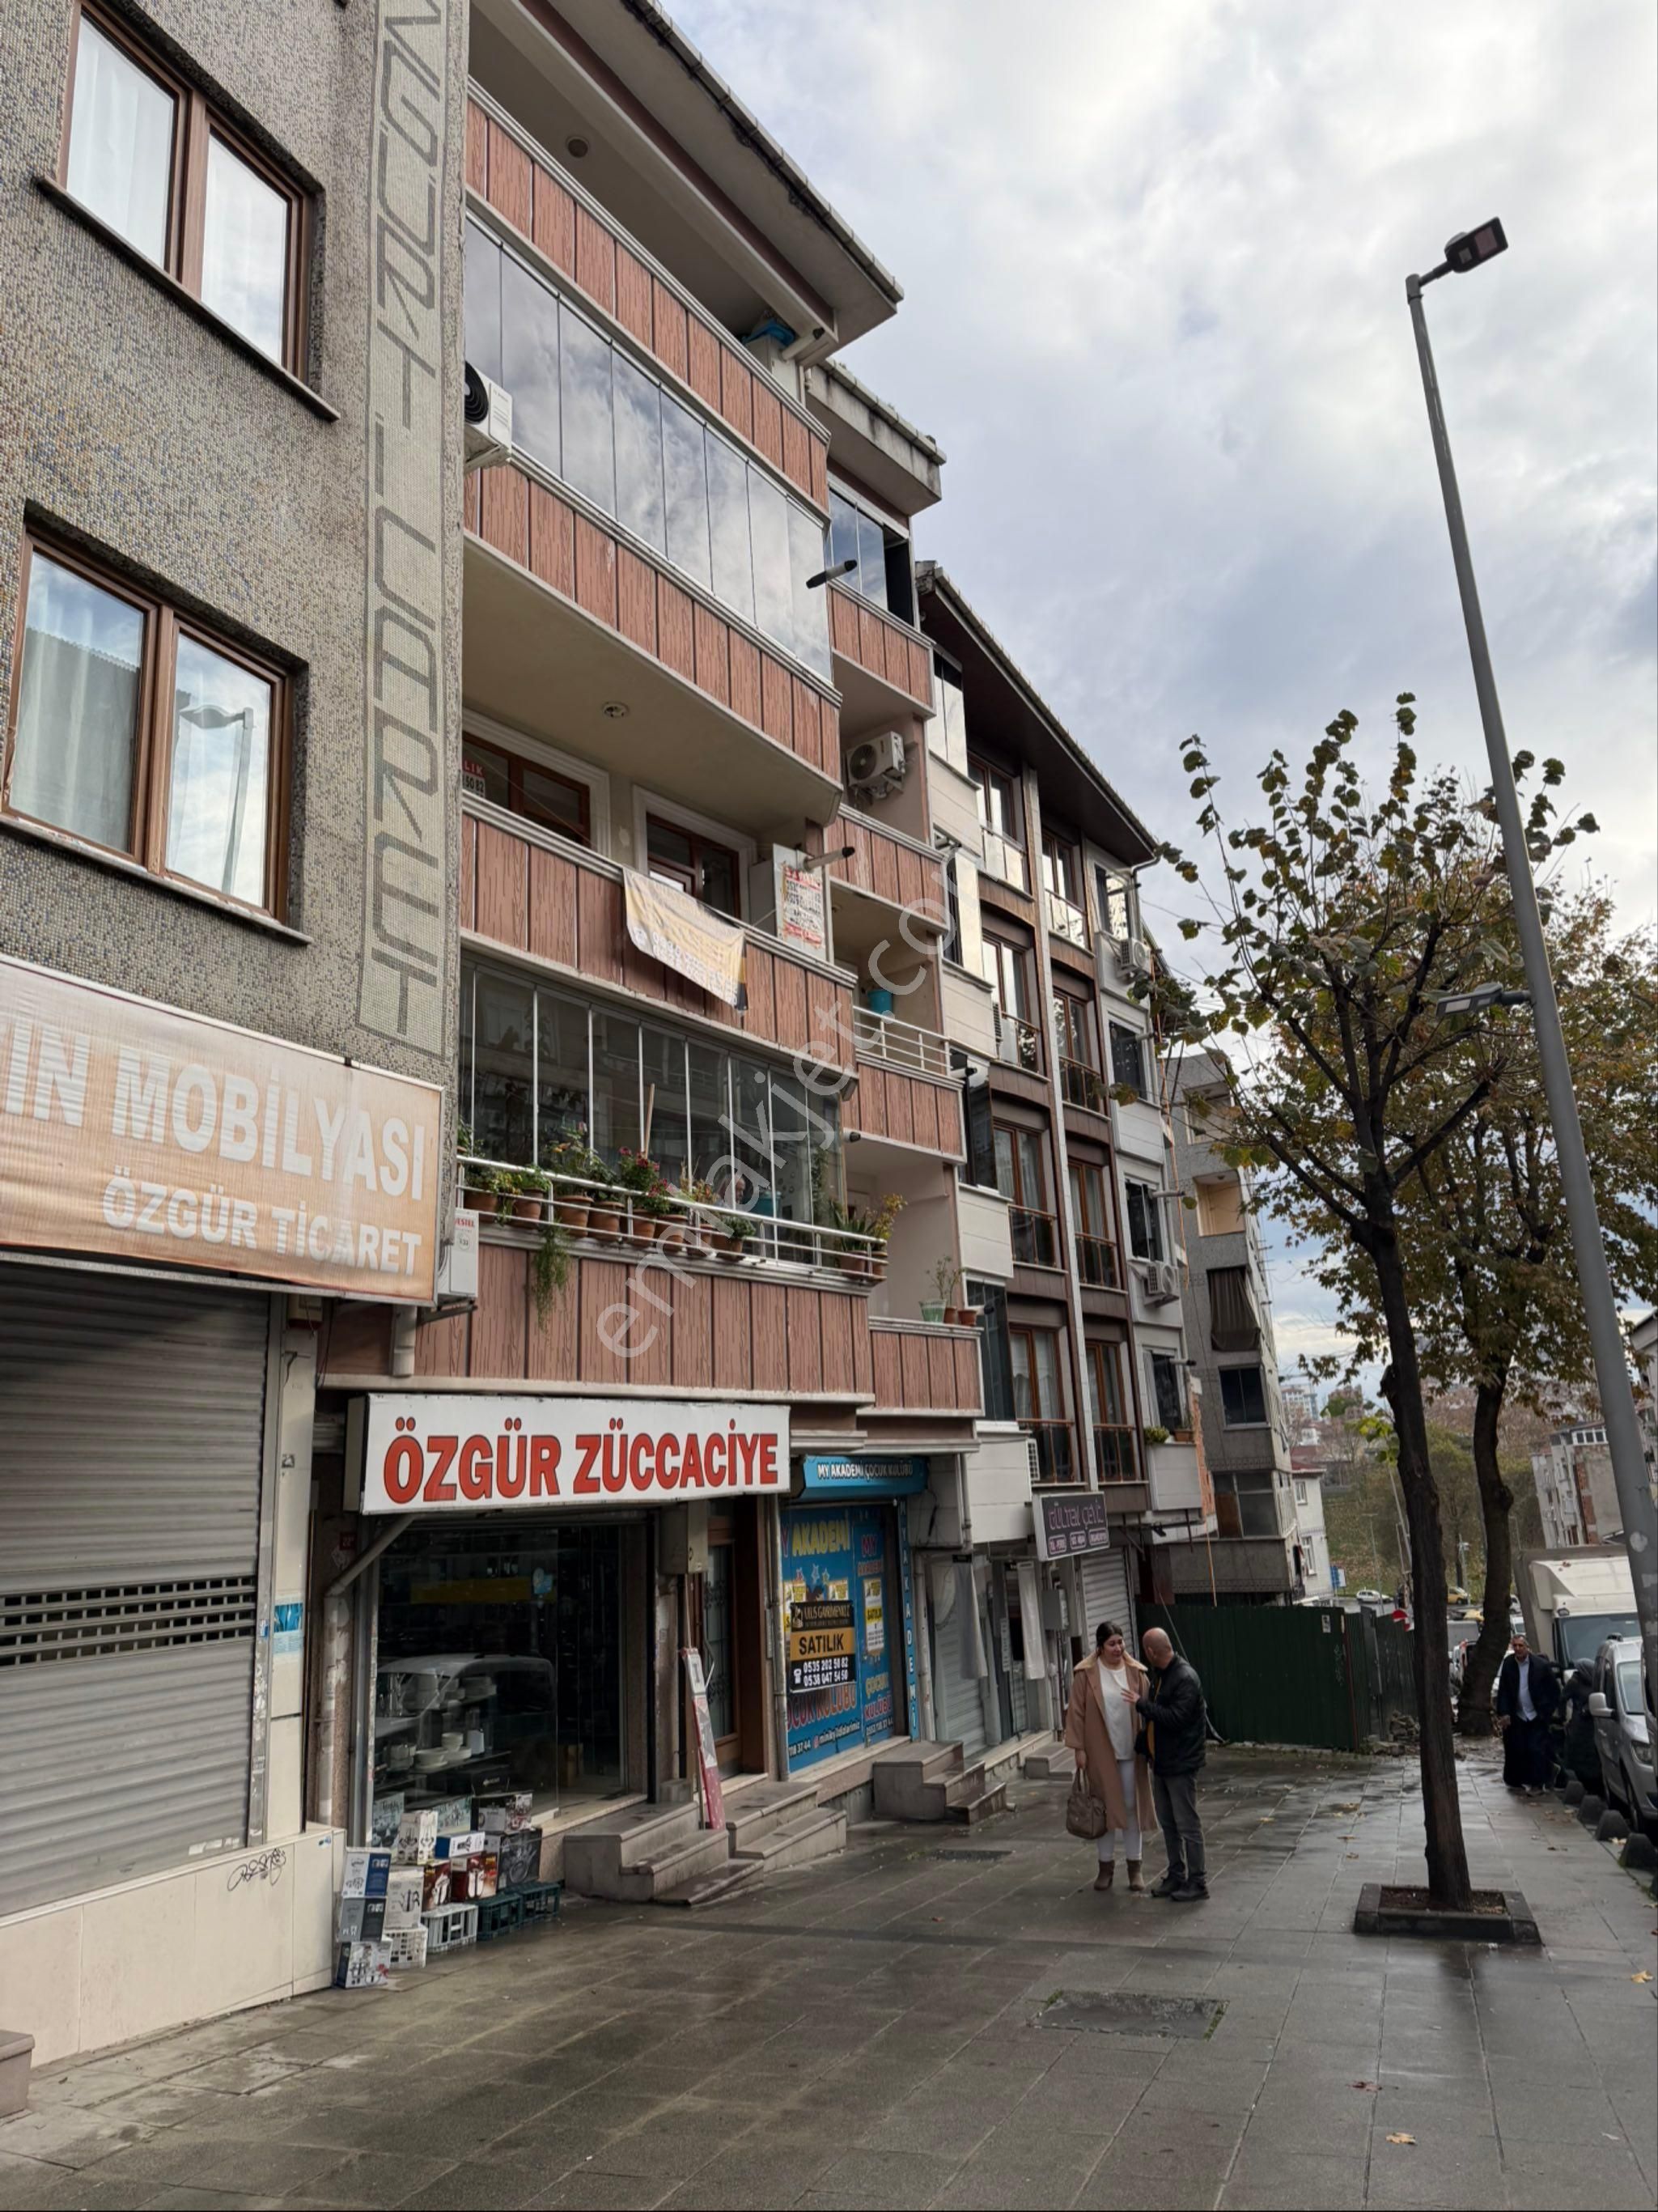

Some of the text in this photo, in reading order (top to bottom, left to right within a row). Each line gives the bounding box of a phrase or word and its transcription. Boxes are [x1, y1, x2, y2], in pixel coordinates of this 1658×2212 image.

[112, 1046, 425, 1201] MOBİLYASI
[103, 1165, 422, 1276] ÖZGÜR TİCARET
[383, 1417, 779, 1505] ÖZGÜR ZÜCCACİYE
[817, 1463, 829, 1478] MY
[831, 1459, 864, 1478] AKADEMİ
[782, 1509, 850, 1558] Y AKADEMİ
[861, 1535, 879, 1558] MY
[799, 1632, 845, 1655] SATILIK
